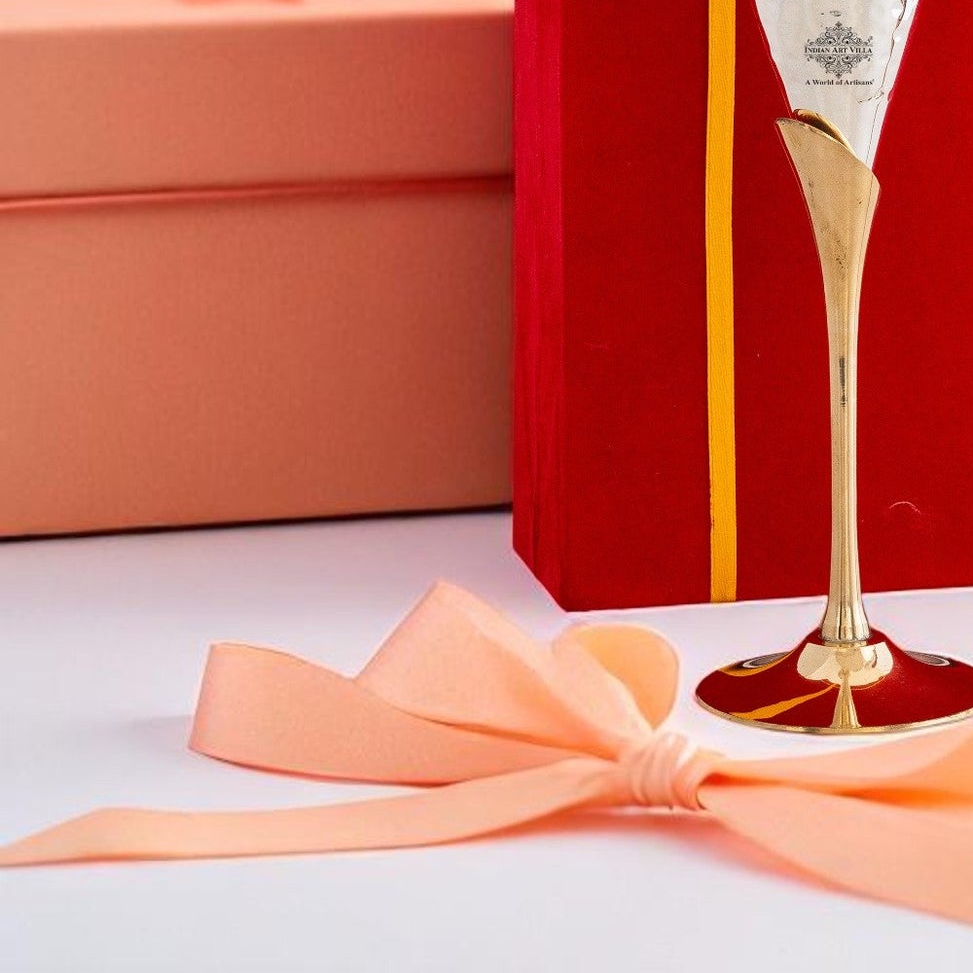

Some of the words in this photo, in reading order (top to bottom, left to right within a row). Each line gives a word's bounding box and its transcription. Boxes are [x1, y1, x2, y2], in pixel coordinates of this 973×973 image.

[804, 46, 830, 54] INDIAN
[832, 46, 848, 54] ART
[849, 46, 873, 54] VILLA
